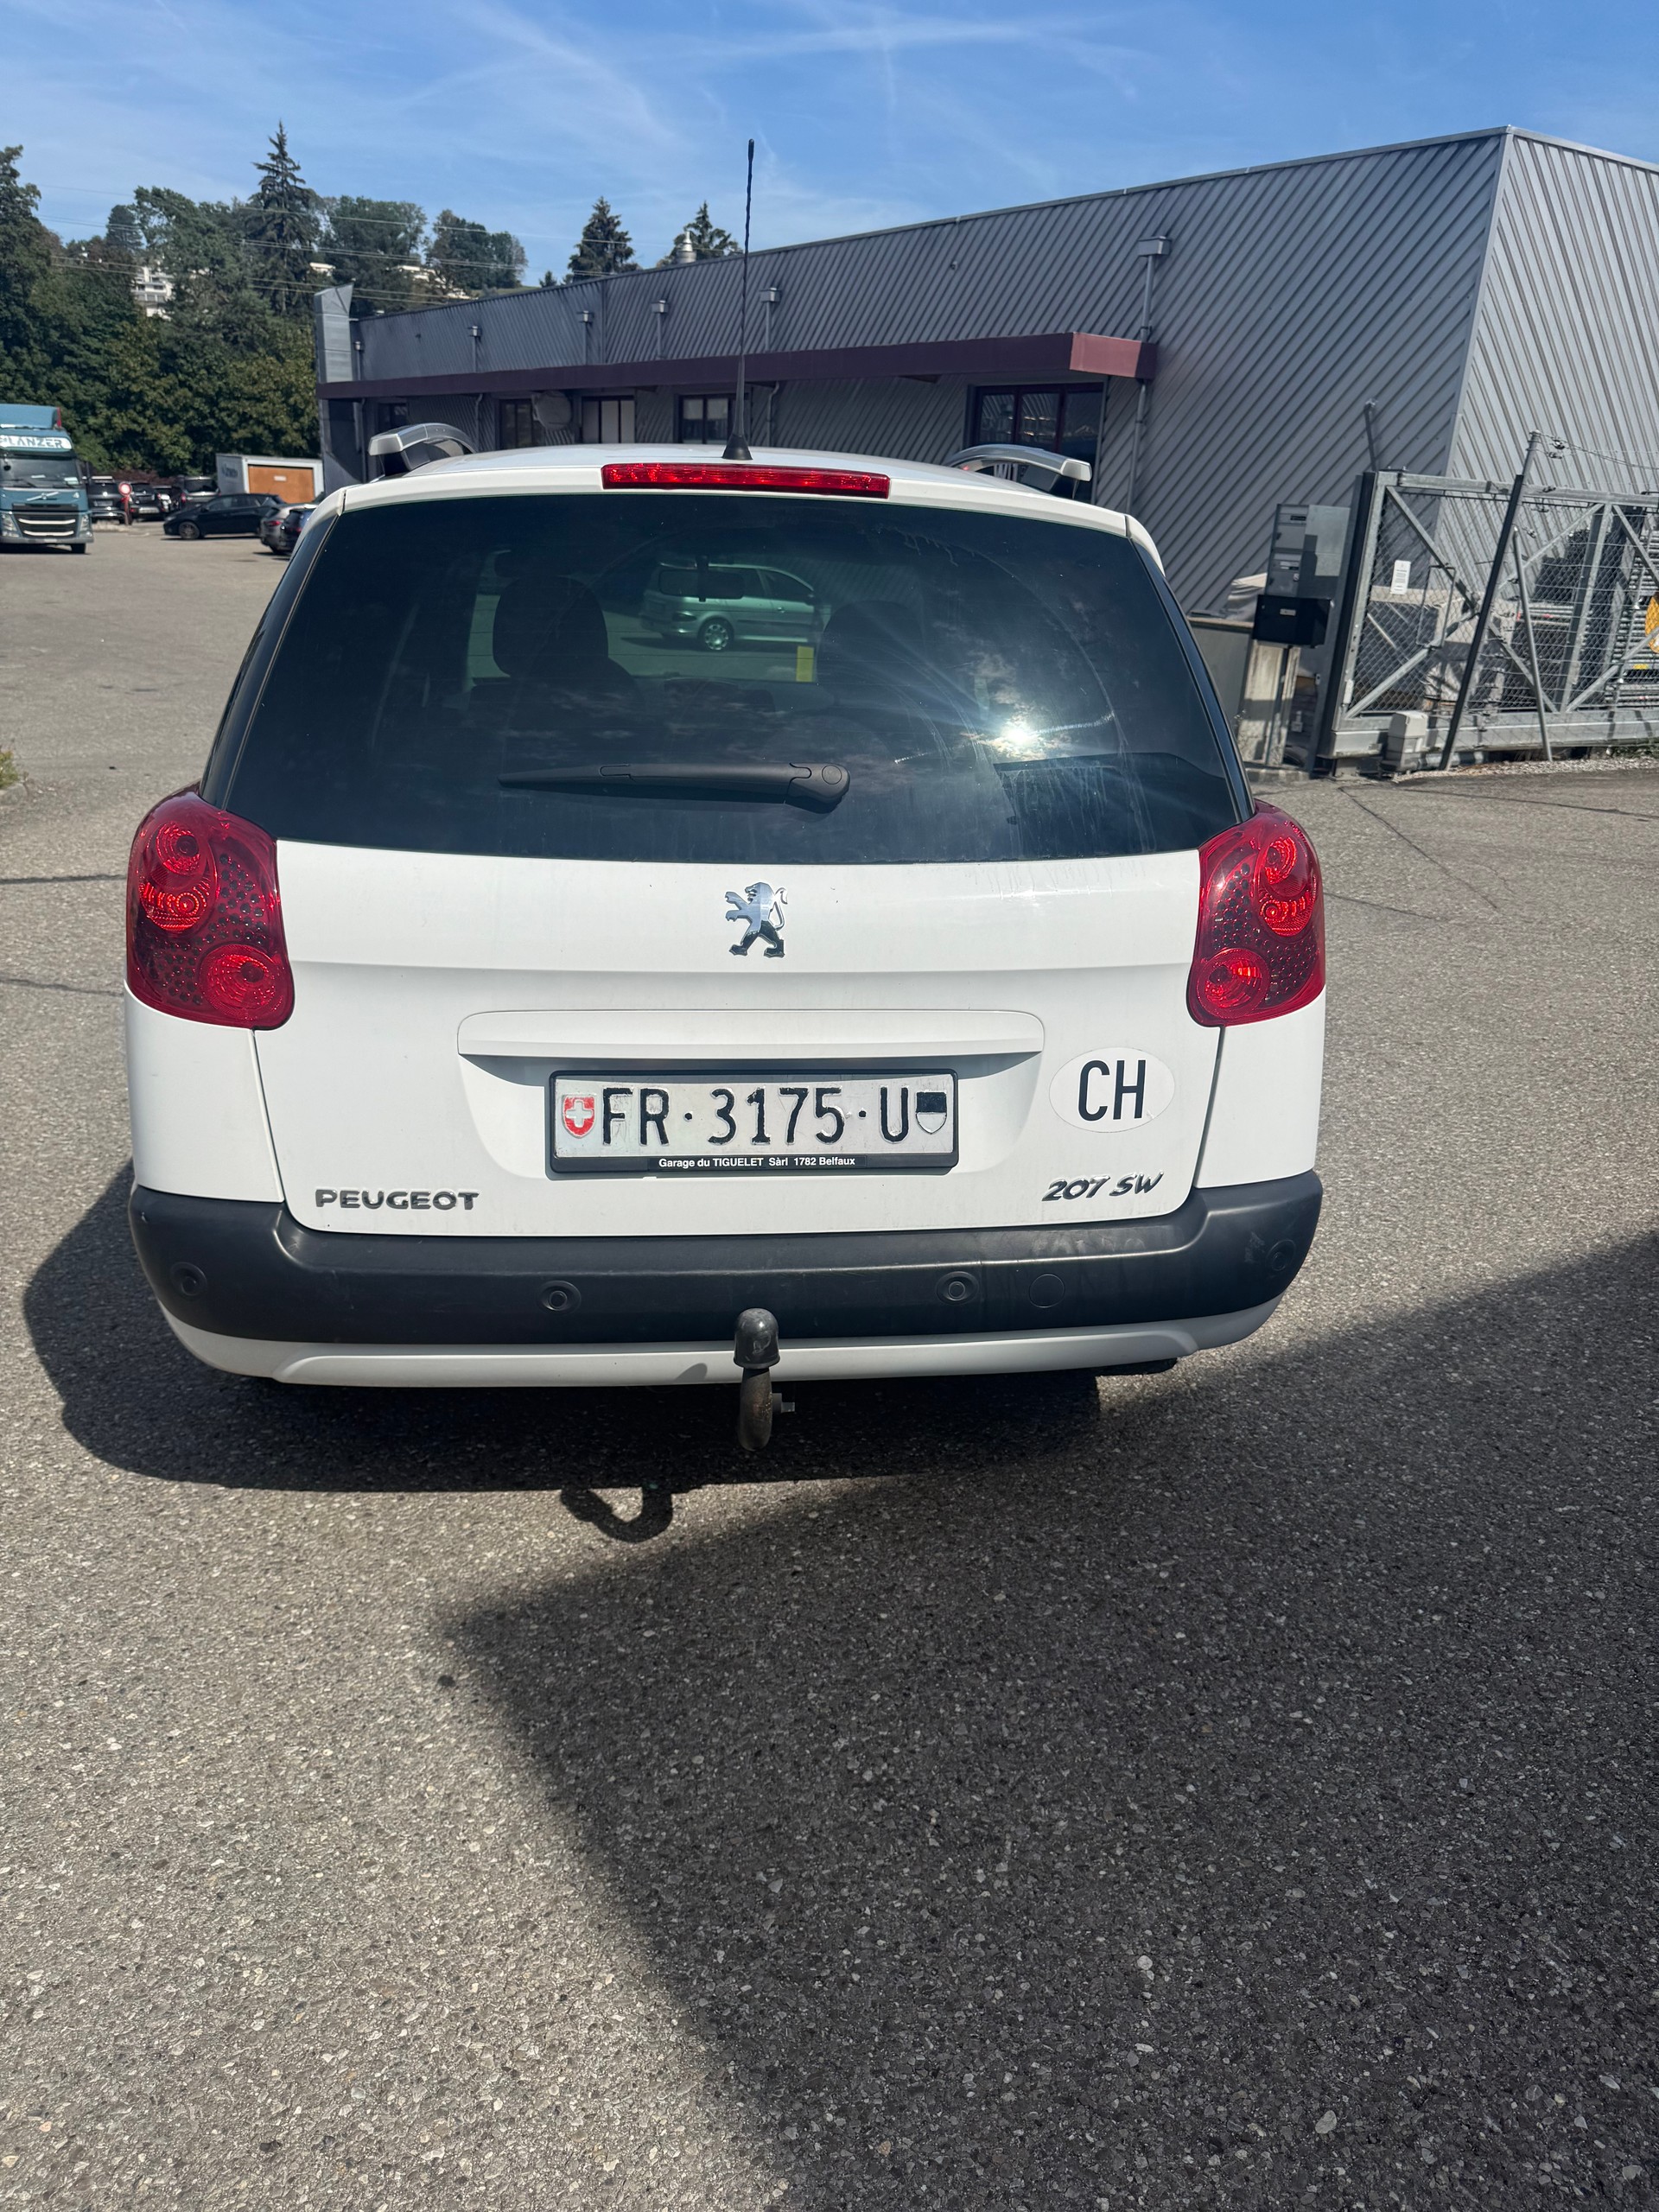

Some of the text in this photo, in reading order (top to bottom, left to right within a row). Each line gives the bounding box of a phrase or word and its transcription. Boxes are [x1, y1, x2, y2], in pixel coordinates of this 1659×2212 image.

[1077, 1059, 1147, 1122] CH
[658, 1158, 696, 1169] Garage
[696, 1158, 710, 1167] du
[712, 1157, 764, 1166] TIGUELET
[793, 1157, 817, 1166] 1782
[818, 1156, 855, 1166] Belfaux
[315, 1188, 480, 1211] PEUGEOT
[1041, 1171, 1165, 1202] 207 SW
